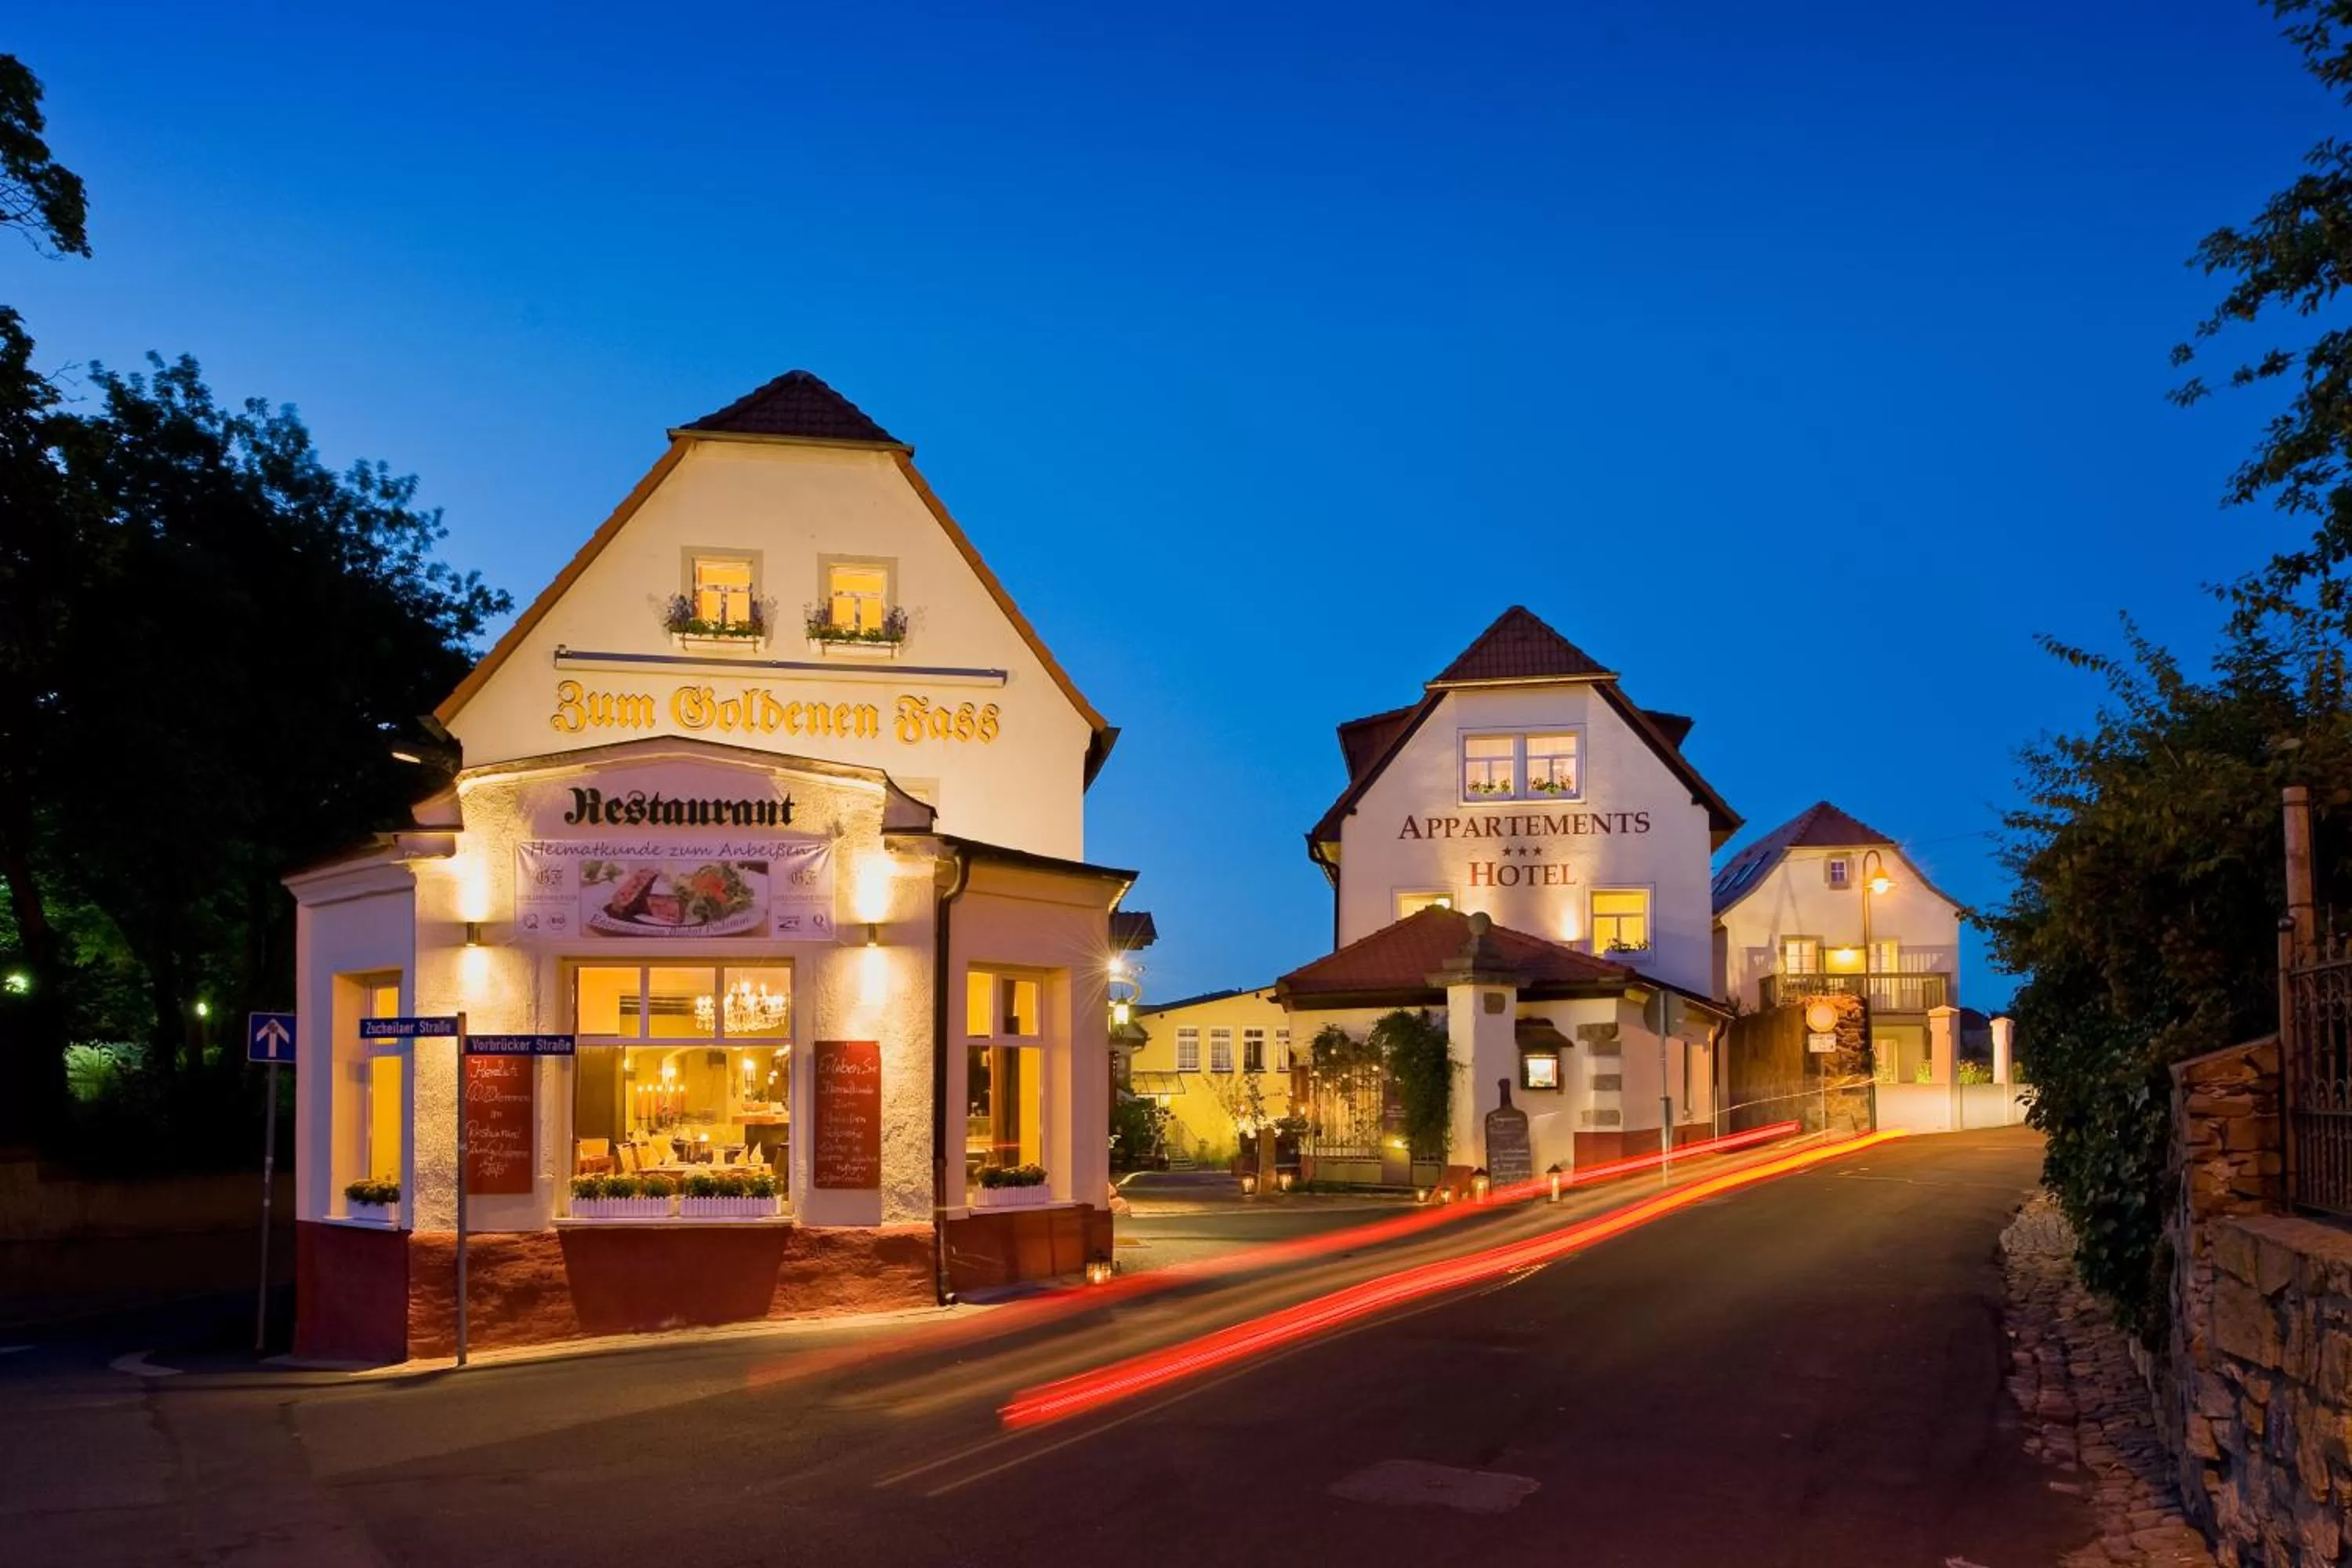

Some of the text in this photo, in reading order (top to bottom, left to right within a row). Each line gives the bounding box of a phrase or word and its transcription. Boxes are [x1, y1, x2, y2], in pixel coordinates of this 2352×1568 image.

[550, 680, 1002, 746] Zum Goldenen Fass
[564, 787, 796, 826] Restaurant
[1398, 811, 1651, 839] APPARTEMENTS
[531, 840, 663, 857] Heimatkunde
[669, 844, 711, 857] zum
[718, 843, 808, 861] Anbeißen
[1468, 862, 1577, 887] HOTEL
[366, 1020, 451, 1034] Zscheilaer Straße
[472, 1037, 572, 1052] Vorbrücker Straße
